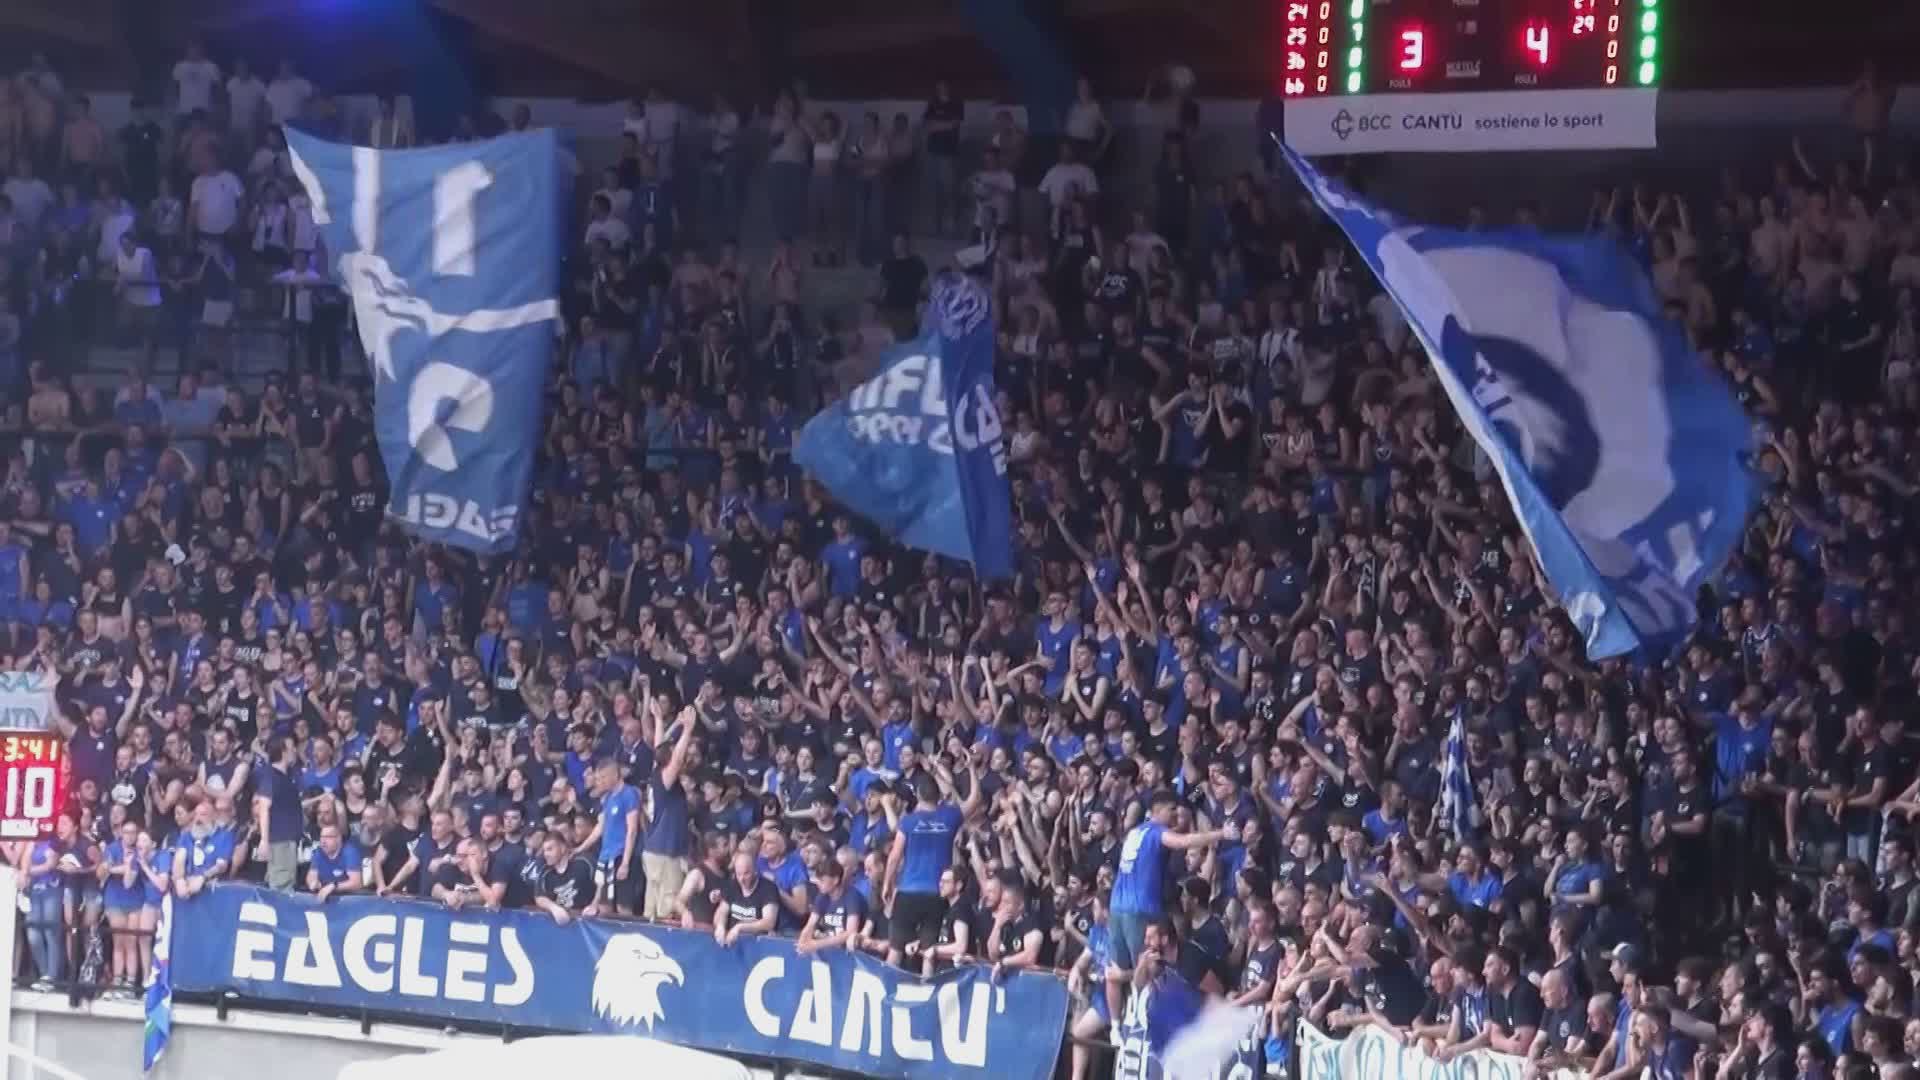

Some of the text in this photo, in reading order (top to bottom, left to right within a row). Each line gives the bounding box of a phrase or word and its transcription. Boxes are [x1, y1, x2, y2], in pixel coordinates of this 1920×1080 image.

[1287, 3, 1308, 21] 24
[1319, 2, 1330, 20] 0
[1572, 15, 1596, 34] 29
[1607, 14, 1619, 33] 0
[1287, 27, 1307, 46] 25
[1318, 27, 1329, 44] 0
[1526, 27, 1549, 64] 4
[1400, 31, 1423, 69] 3
[1607, 40, 1618, 58] 0
[1317, 51, 1328, 68] 0
[1317, 75, 1327, 92] 0
[1606, 65, 1617, 84] 0
[1358, 114, 1392, 132] BCC
[1474, 113, 1541, 130] sostiene
[1544, 113, 1559, 128] lo
[1563, 112, 1604, 130] sport
[4, 736, 58, 762] 3:41
[5, 766, 56, 819] 10
[232, 901, 536, 1007] EAGLES
